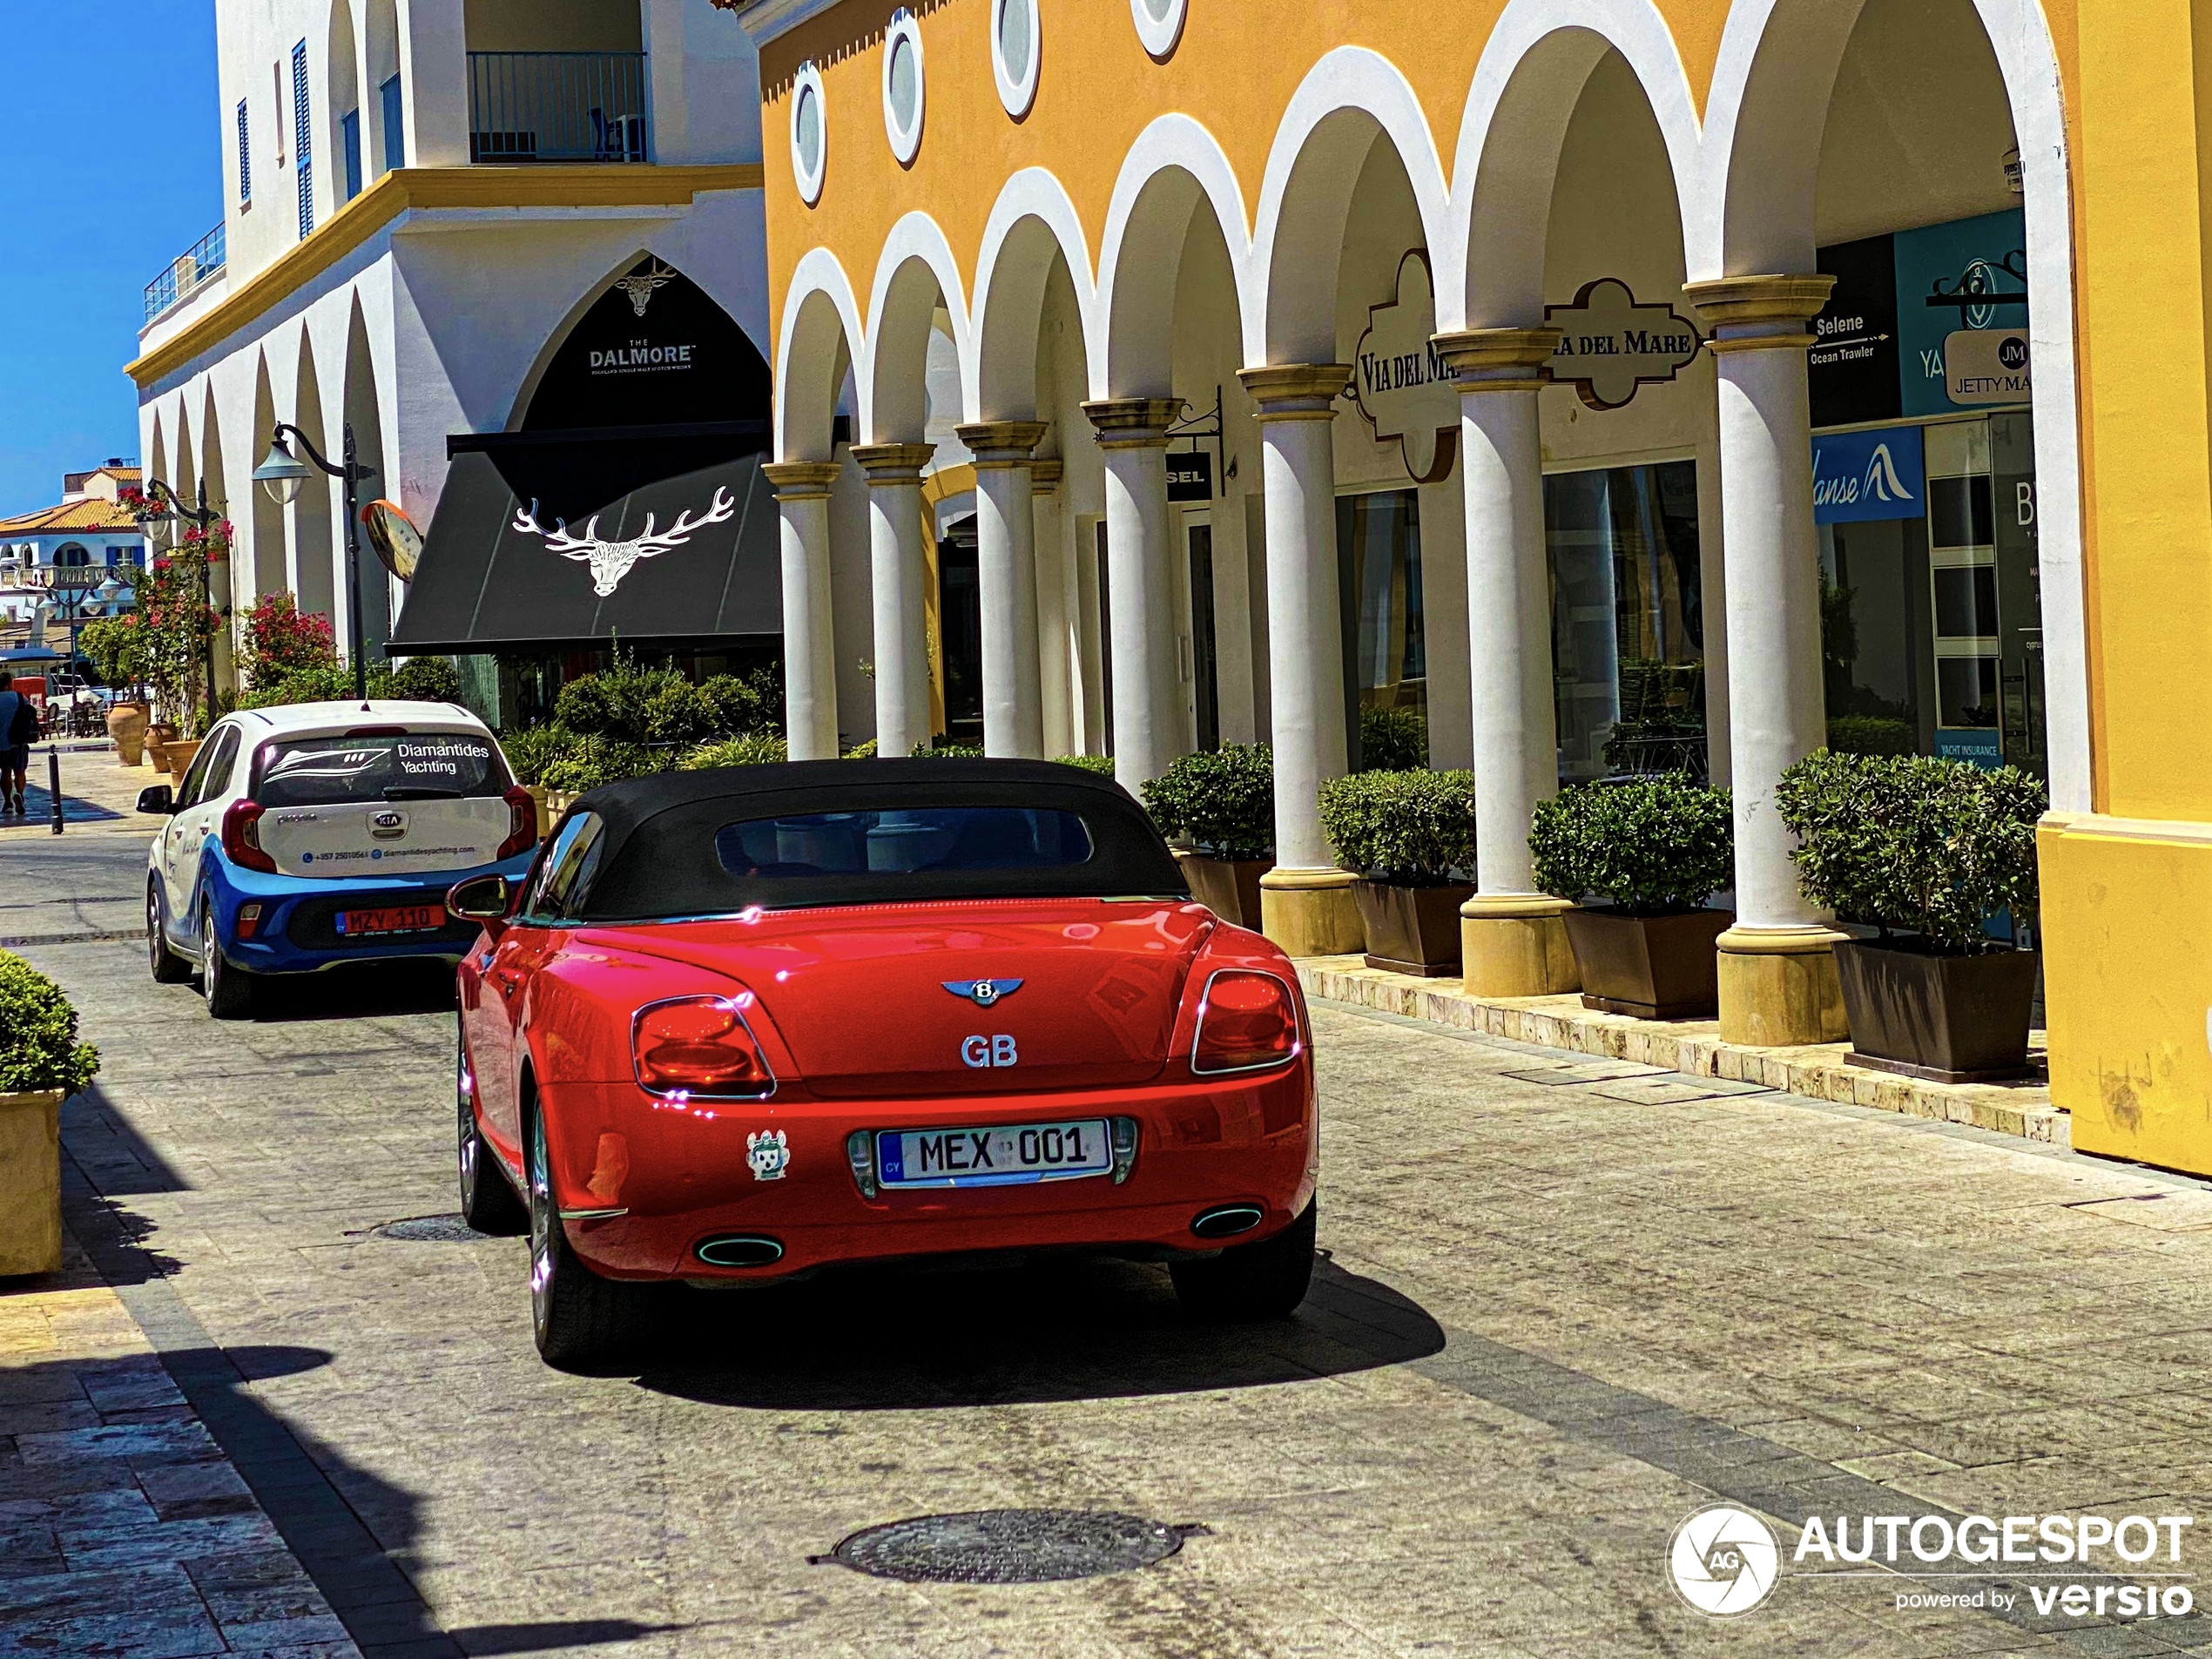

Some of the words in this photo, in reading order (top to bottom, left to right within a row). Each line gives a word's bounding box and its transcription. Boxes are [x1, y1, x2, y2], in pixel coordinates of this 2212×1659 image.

[1817, 316, 1864, 336] Selene
[1623, 330, 1691, 354] MARE
[590, 345, 691, 368] DALMORE
[1811, 353, 1838, 365] Ocean
[1839, 346, 1874, 361] Trawler
[2002, 346, 2026, 361] JM
[1955, 377, 2003, 394] JETTY
[1166, 471, 1205, 483] SEL
[397, 743, 489, 758] Diamantides
[1941, 745, 1961, 755] YACHT
[1961, 745, 1997, 757] INSURANCE
[401, 760, 456, 775] Yachting
[379, 817, 398, 826] KIA
[395, 908, 430, 927] 110
[961, 1035, 1018, 1069] GB
[920, 1132, 994, 1172] MEX
[1019, 1128, 1087, 1165] 001
[886, 1162, 900, 1174] CY
